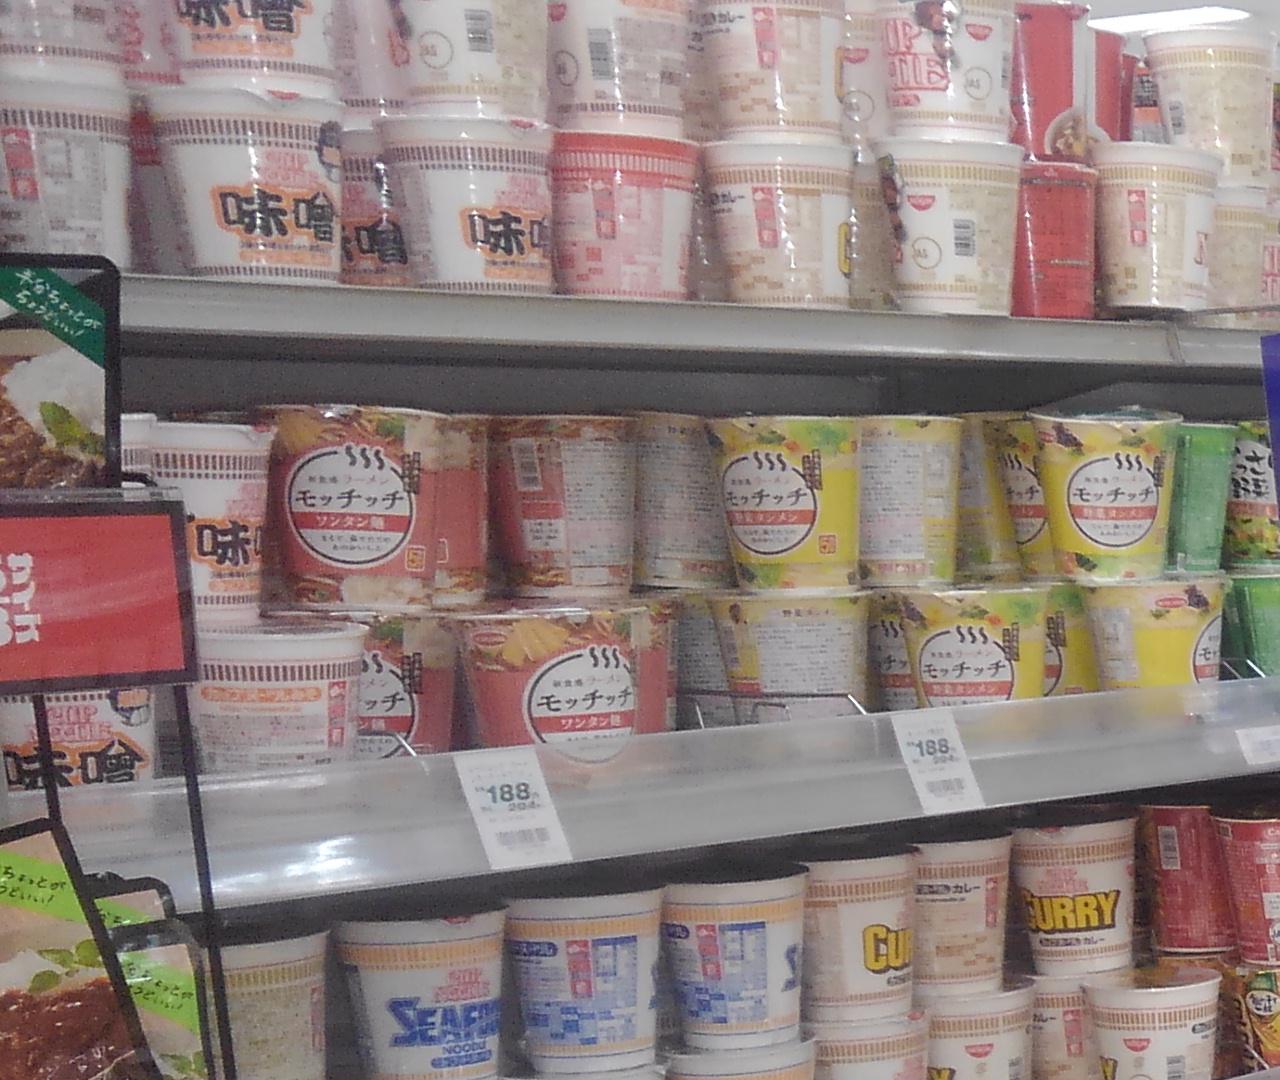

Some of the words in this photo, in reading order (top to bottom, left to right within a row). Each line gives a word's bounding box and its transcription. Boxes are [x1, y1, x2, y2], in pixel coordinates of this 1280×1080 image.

[220, 187, 338, 243] 味噌
[296, 488, 405, 510] モッチッチ
[726, 487, 809, 508] モッチッチ
[1073, 485, 1155, 505] モッチッチ
[196, 520, 263, 566] 味
[923, 659, 1008, 680] モッチッチ
[536, 690, 634, 712] モッチッチ
[916, 737, 950, 759] 188
[486, 781, 531, 804] 188
[1027, 889, 1122, 934] URRY
[388, 997, 503, 1047] SEAF
